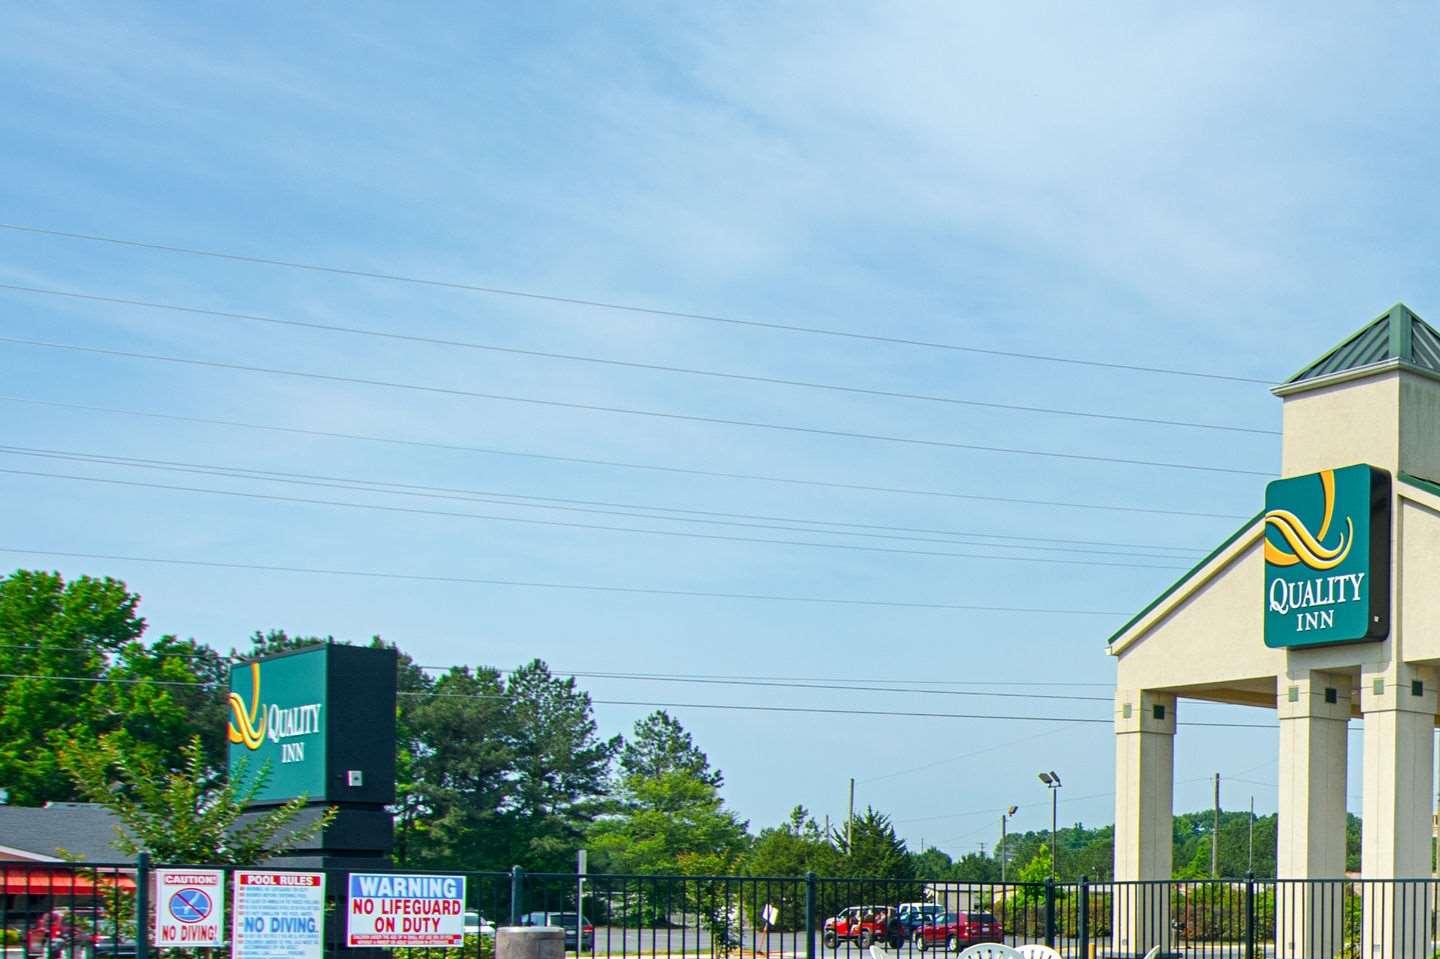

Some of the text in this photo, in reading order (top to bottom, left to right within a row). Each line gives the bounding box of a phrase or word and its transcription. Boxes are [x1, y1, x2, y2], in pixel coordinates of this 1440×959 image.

[1269, 572, 1365, 615] QUALITY
[1296, 609, 1335, 632] INN
[267, 703, 322, 744] QUALITY
[281, 742, 305, 763] INN
[247, 875, 314, 886] POOL RULES
[359, 876, 457, 898] WARNING
[352, 898, 461, 915] NO LIFEGUARD
[162, 925, 218, 941] NO DIVING!
[243, 917, 265, 933] NO
[374, 916, 441, 933] ON DUTY
